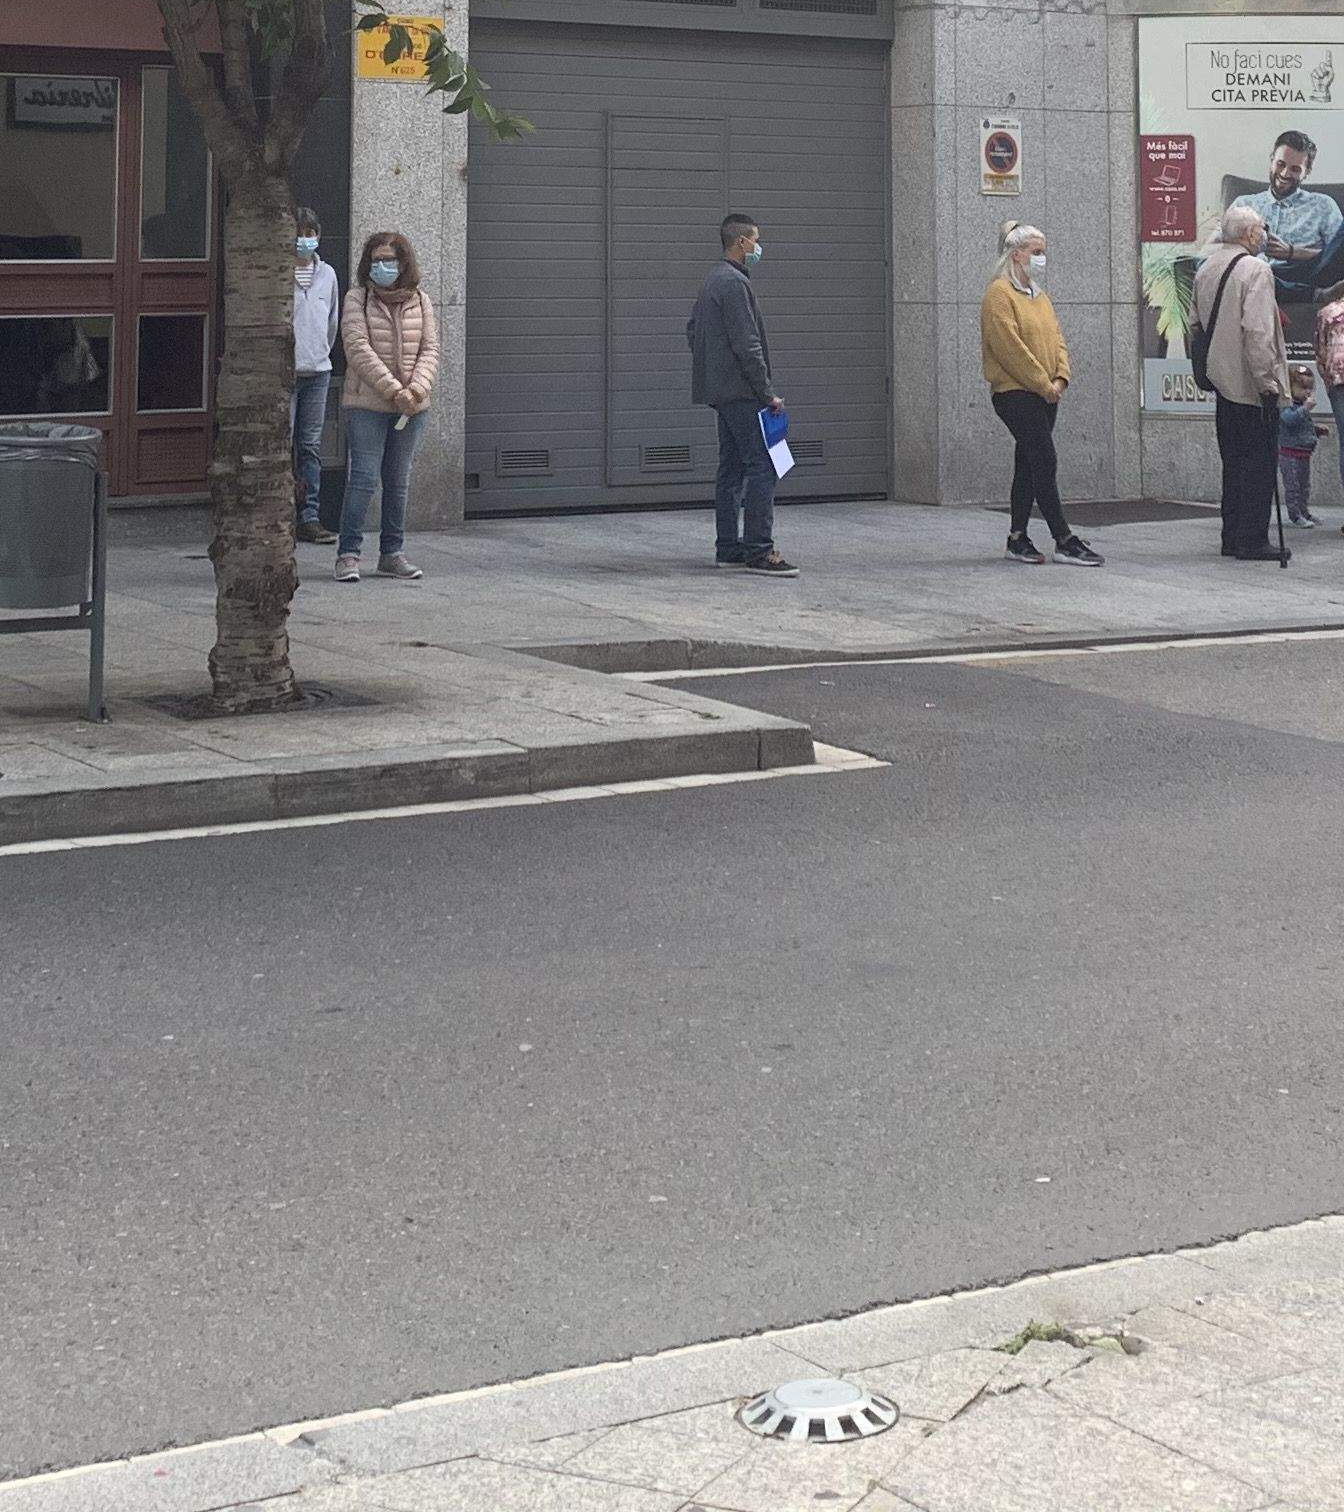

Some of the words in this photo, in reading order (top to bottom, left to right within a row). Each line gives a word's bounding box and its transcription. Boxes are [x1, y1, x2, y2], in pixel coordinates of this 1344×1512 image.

[1210, 50, 1230, 69] No
[1233, 48, 1262, 75] faci
[1266, 53, 1303, 69] cues
[1226, 73, 1291, 86] DEMANI
[1211, 89, 1246, 103] CITA
[1251, 85, 1306, 103] PRÈVIA
[1146, 141, 1166, 150] Més
[1148, 152, 1166, 162] que
[1168, 150, 1186, 160] mai
